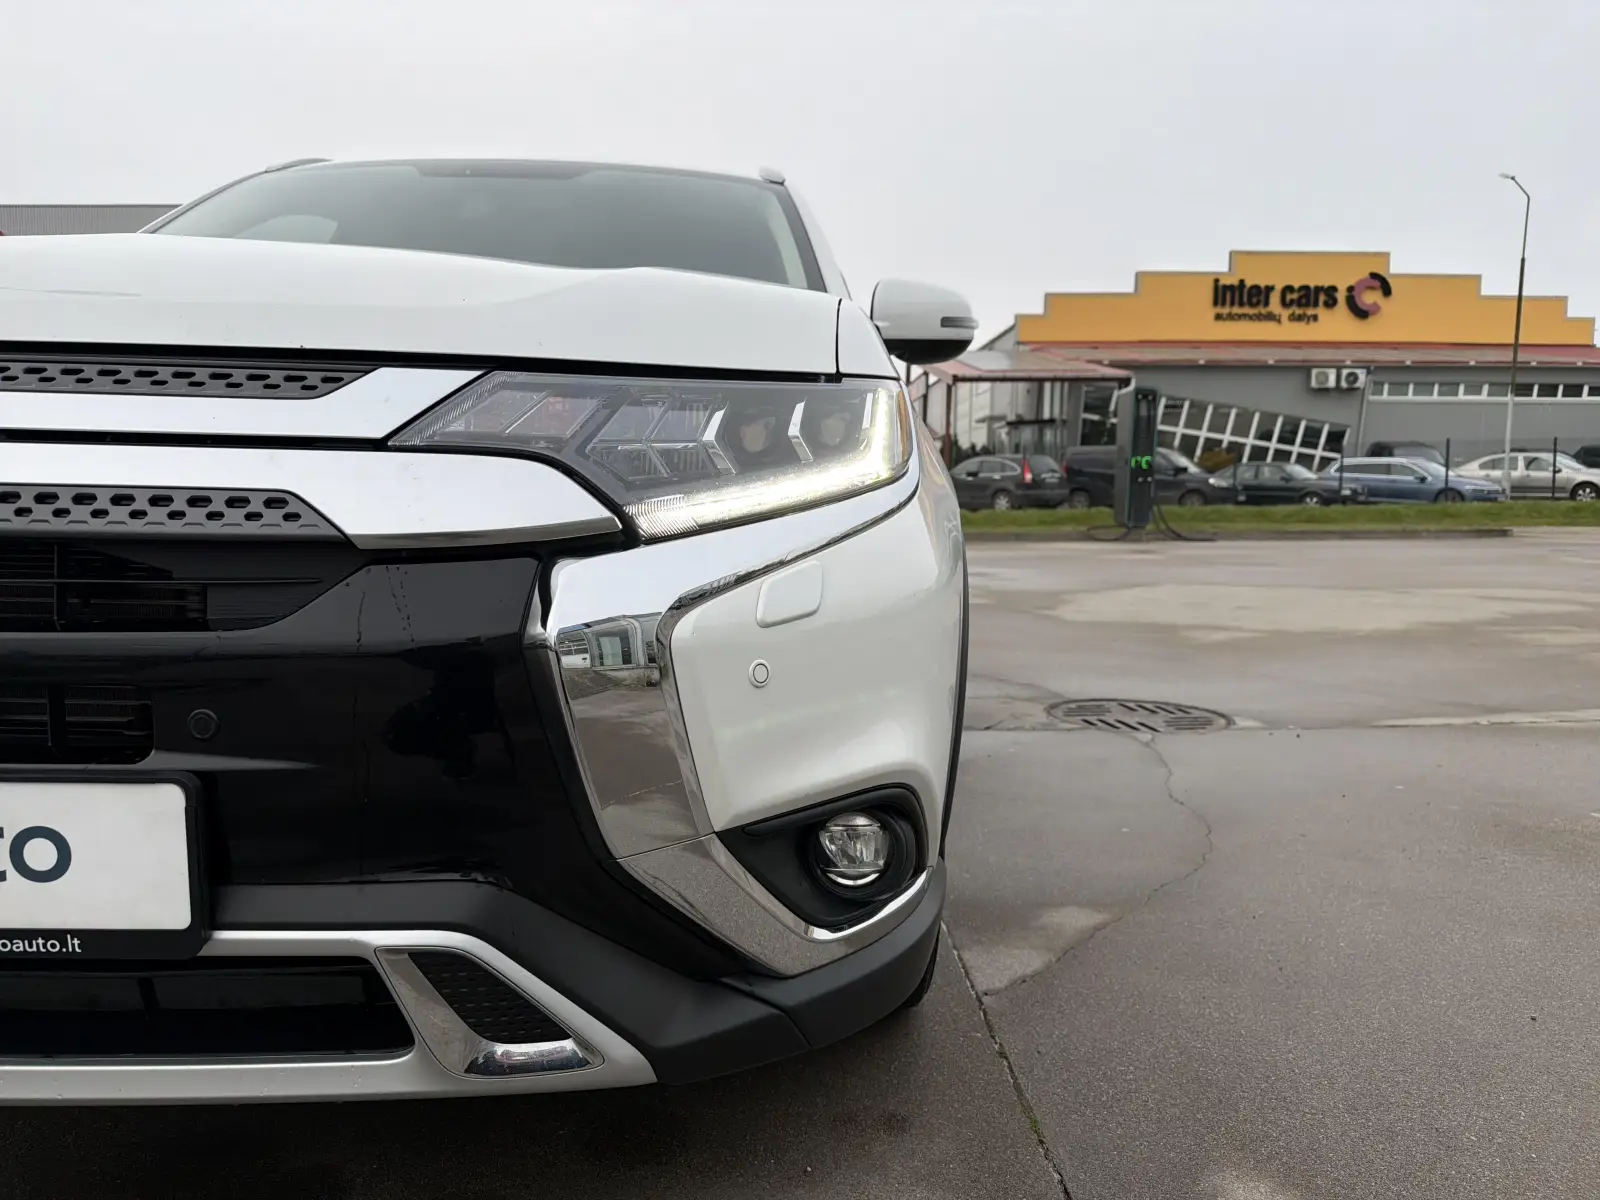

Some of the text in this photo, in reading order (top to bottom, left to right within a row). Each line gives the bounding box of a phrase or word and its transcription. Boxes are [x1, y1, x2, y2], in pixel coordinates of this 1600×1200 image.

[1213, 278, 1338, 309] inter cars
[1288, 311, 1318, 325] dalys
[0, 934, 82, 952] oauto.lt
